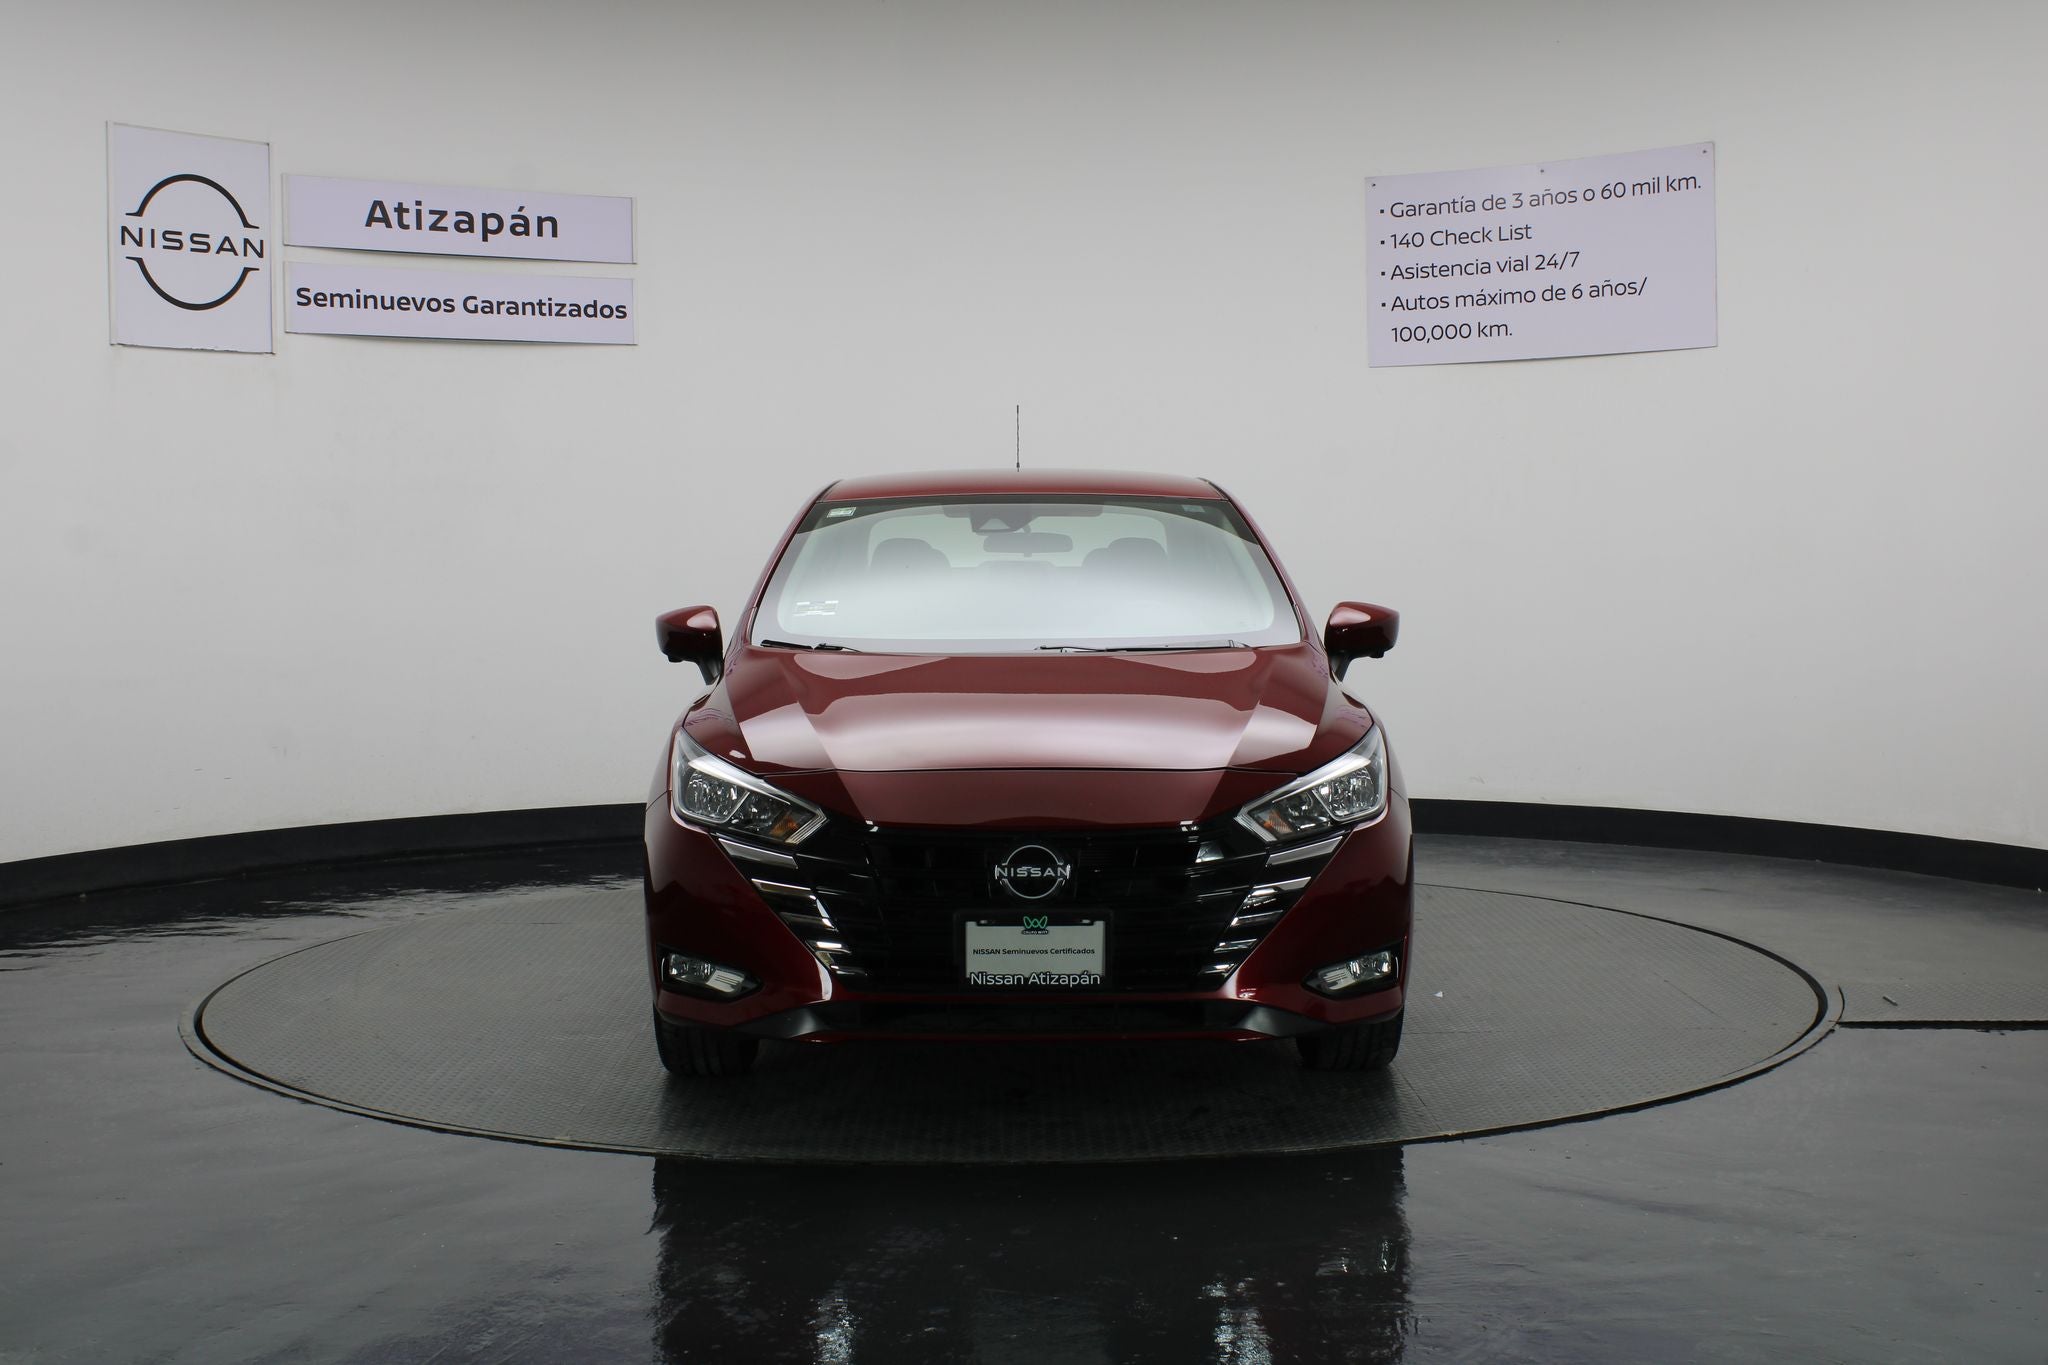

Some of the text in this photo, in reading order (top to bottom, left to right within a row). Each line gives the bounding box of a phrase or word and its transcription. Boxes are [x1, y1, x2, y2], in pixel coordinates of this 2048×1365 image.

[1390, 175, 1702, 218] Garantía de 3 años o 60 mil km.
[364, 199, 559, 243] Atizapán
[120, 225, 265, 259] NISSAN
[1390, 224, 1533, 249] 140 Check List
[1390, 251, 1581, 281] Asistencia vial 24/7
[296, 286, 628, 320] Seminuevos Garantizados
[1390, 276, 1648, 312] Autos máximo de 6 años/
[1391, 321, 1513, 344] 100,000 km.
[996, 866, 1069, 878] NISSAN
[1002, 947, 1049, 955] Seminuevos
[1050, 947, 1096, 955] Certificados
[970, 970, 1101, 988] Nissan Atizapán
